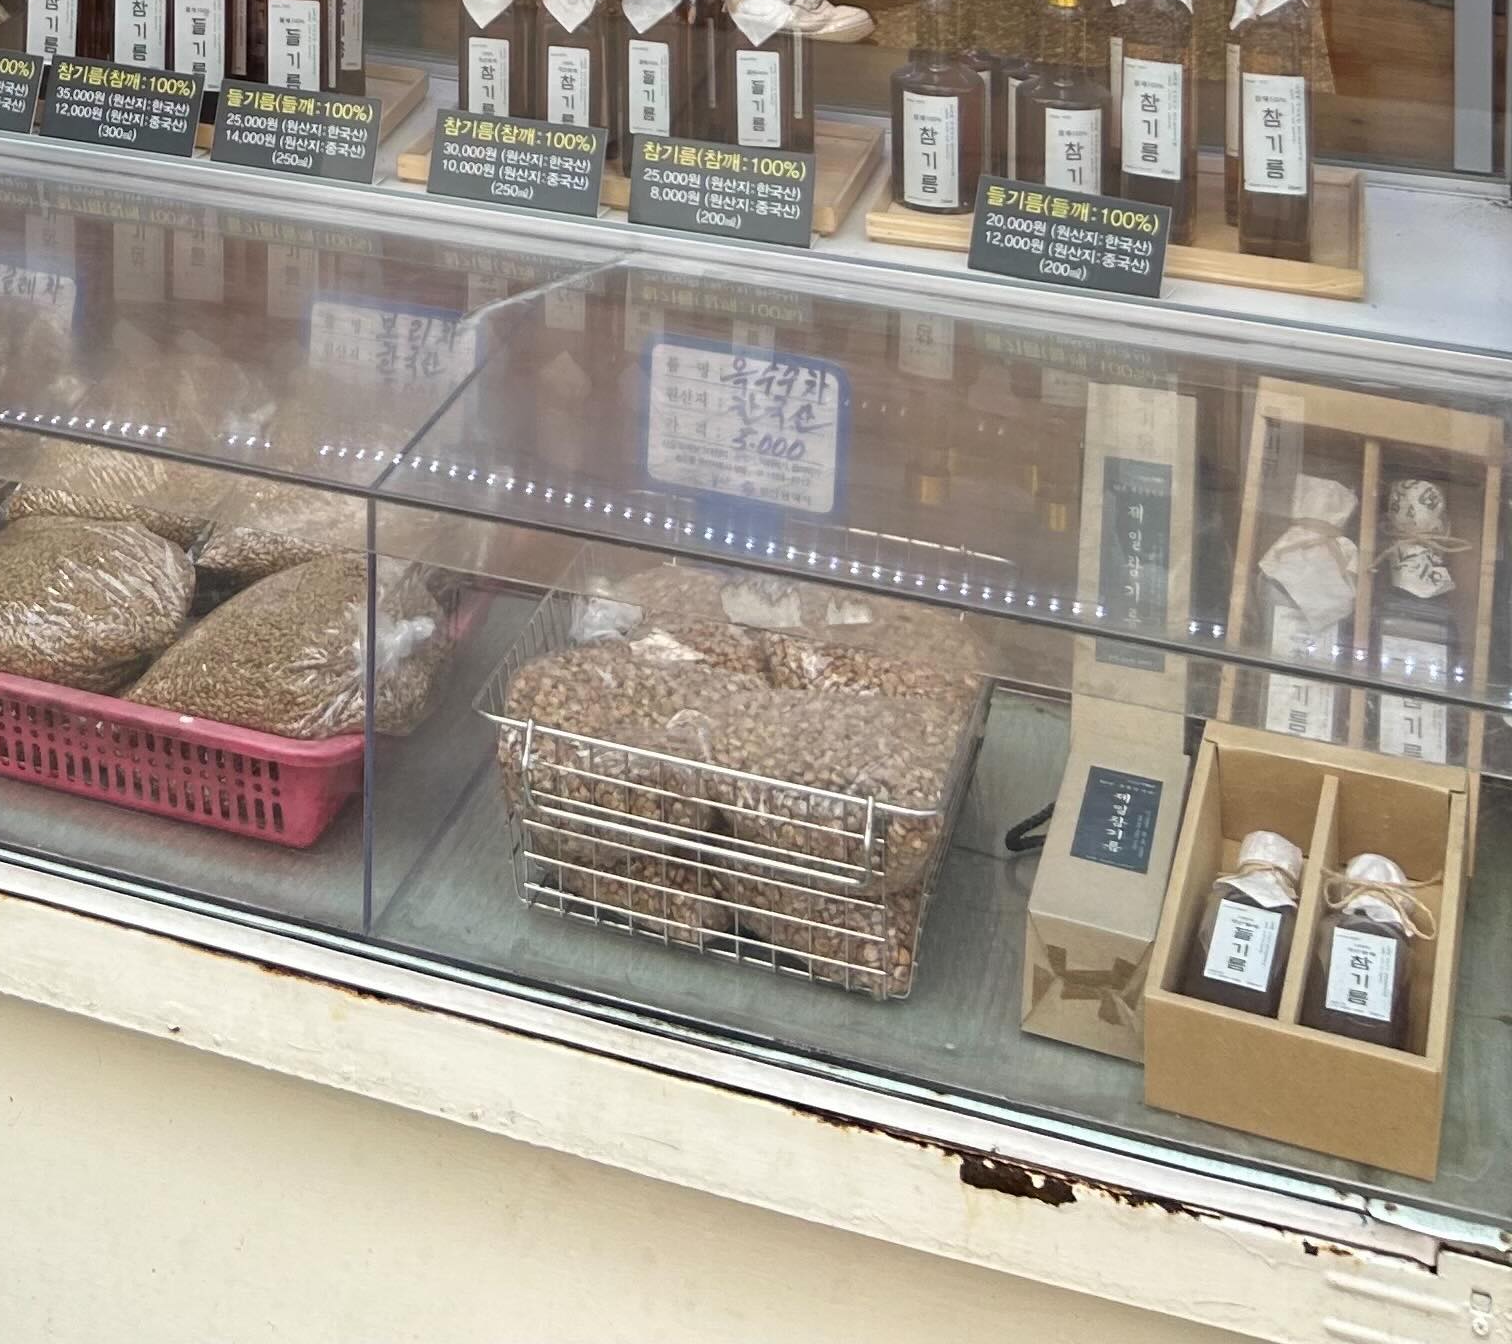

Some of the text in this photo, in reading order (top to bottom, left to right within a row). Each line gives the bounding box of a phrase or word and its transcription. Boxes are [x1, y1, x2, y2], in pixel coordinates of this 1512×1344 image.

[132, 0, 149, 62] 참기름
[919, 126, 939, 194] 참기름
[1140, 92, 1161, 164] 참기름
[1262, 107, 1285, 180] 참기름
[1064, 141, 1084, 185] 참기
[1347, 953, 1375, 1007] 참기름
